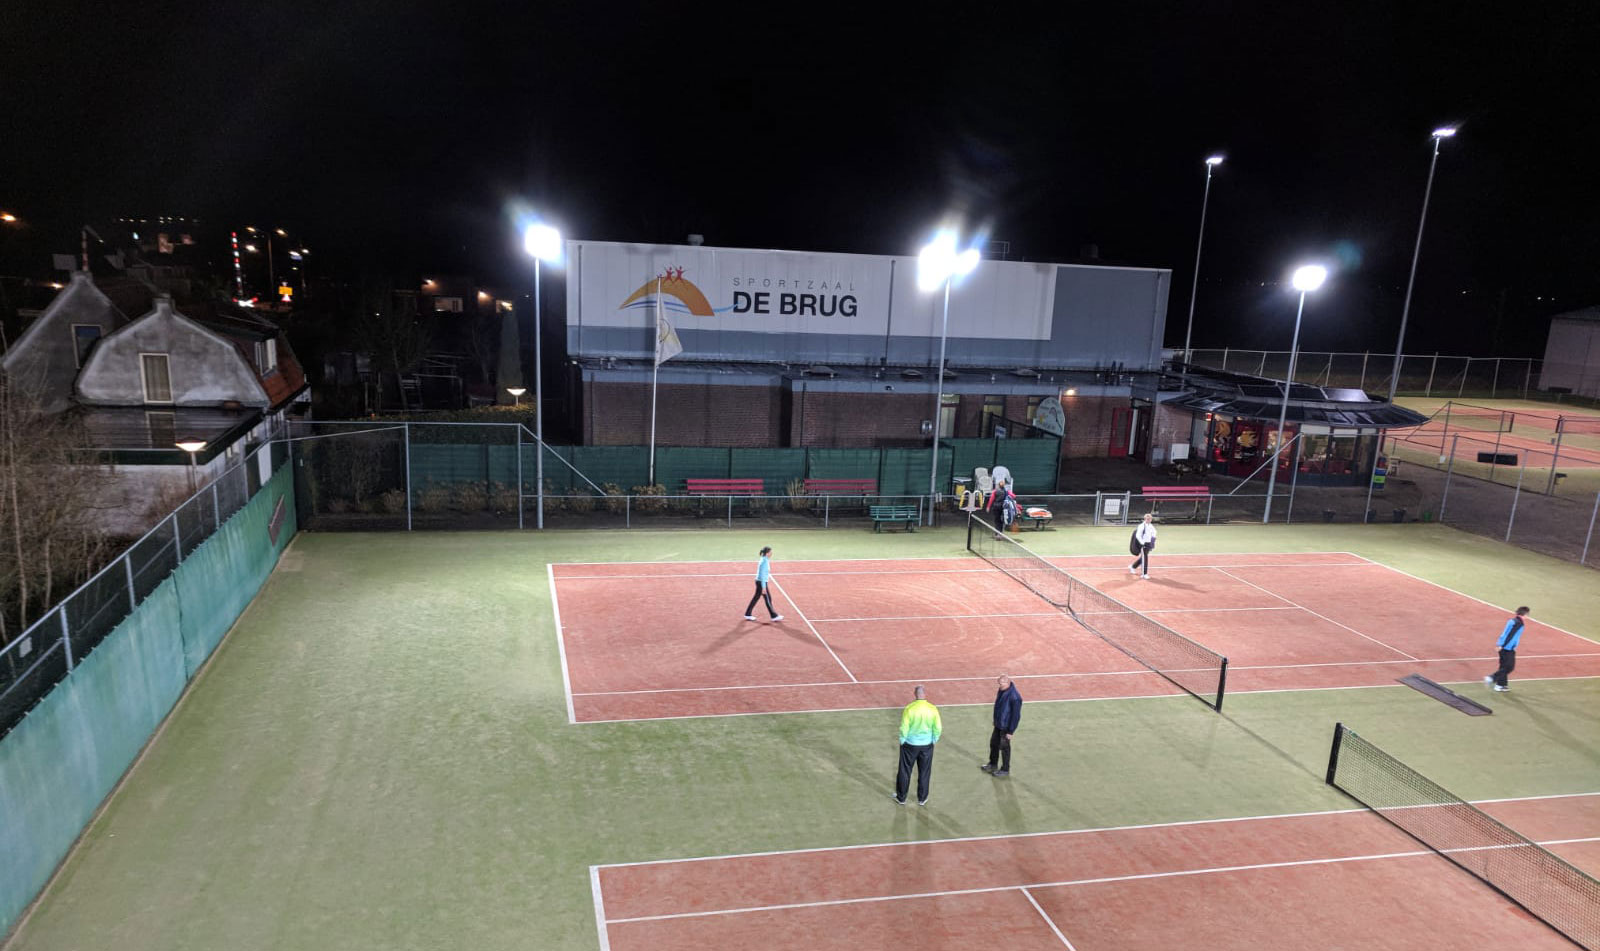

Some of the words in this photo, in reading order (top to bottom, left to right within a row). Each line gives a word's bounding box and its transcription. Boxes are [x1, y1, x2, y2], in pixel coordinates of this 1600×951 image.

[733, 278, 854, 291] SPORTZAAL
[733, 291, 770, 314] DE
[780, 293, 857, 317] BRUG
